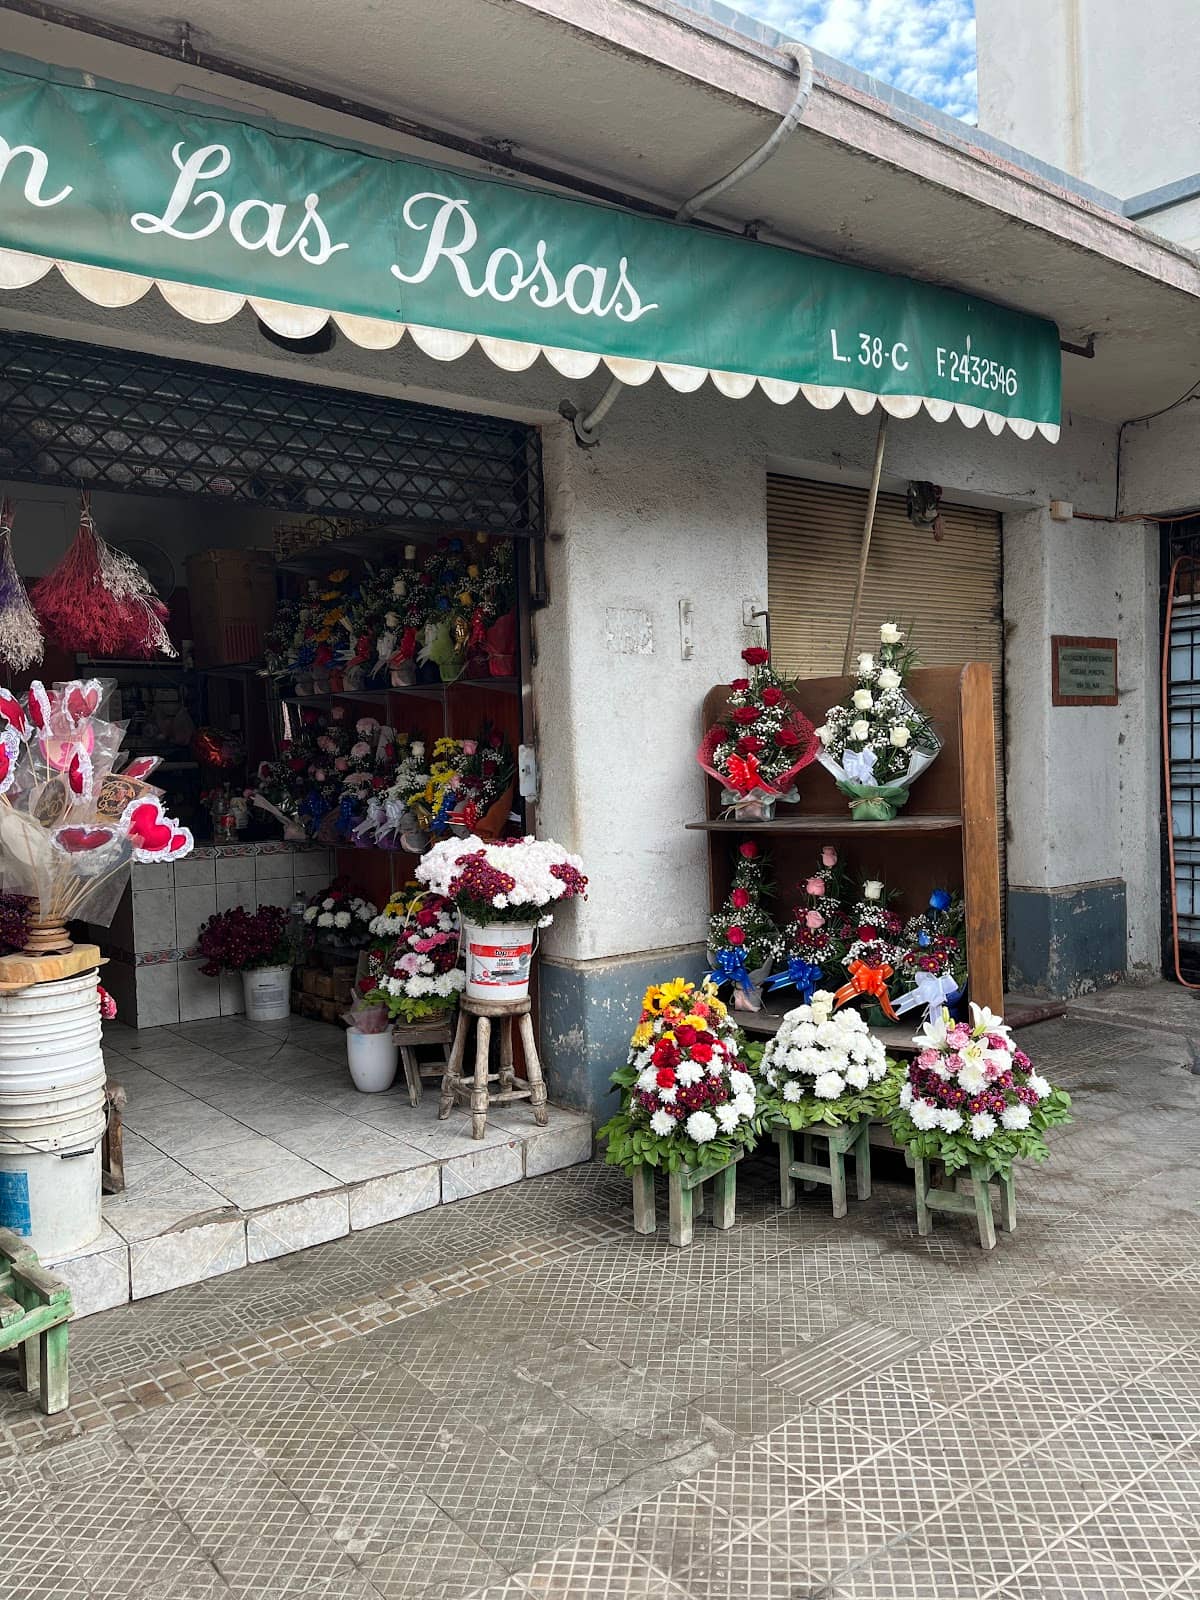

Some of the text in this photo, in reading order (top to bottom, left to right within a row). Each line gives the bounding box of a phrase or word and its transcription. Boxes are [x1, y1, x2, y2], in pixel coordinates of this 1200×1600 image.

[130, 141, 350, 266] Las
[390, 192, 659, 323] Rosas
[830, 328, 851, 363] L.
[858, 333, 909, 372] 38-C
